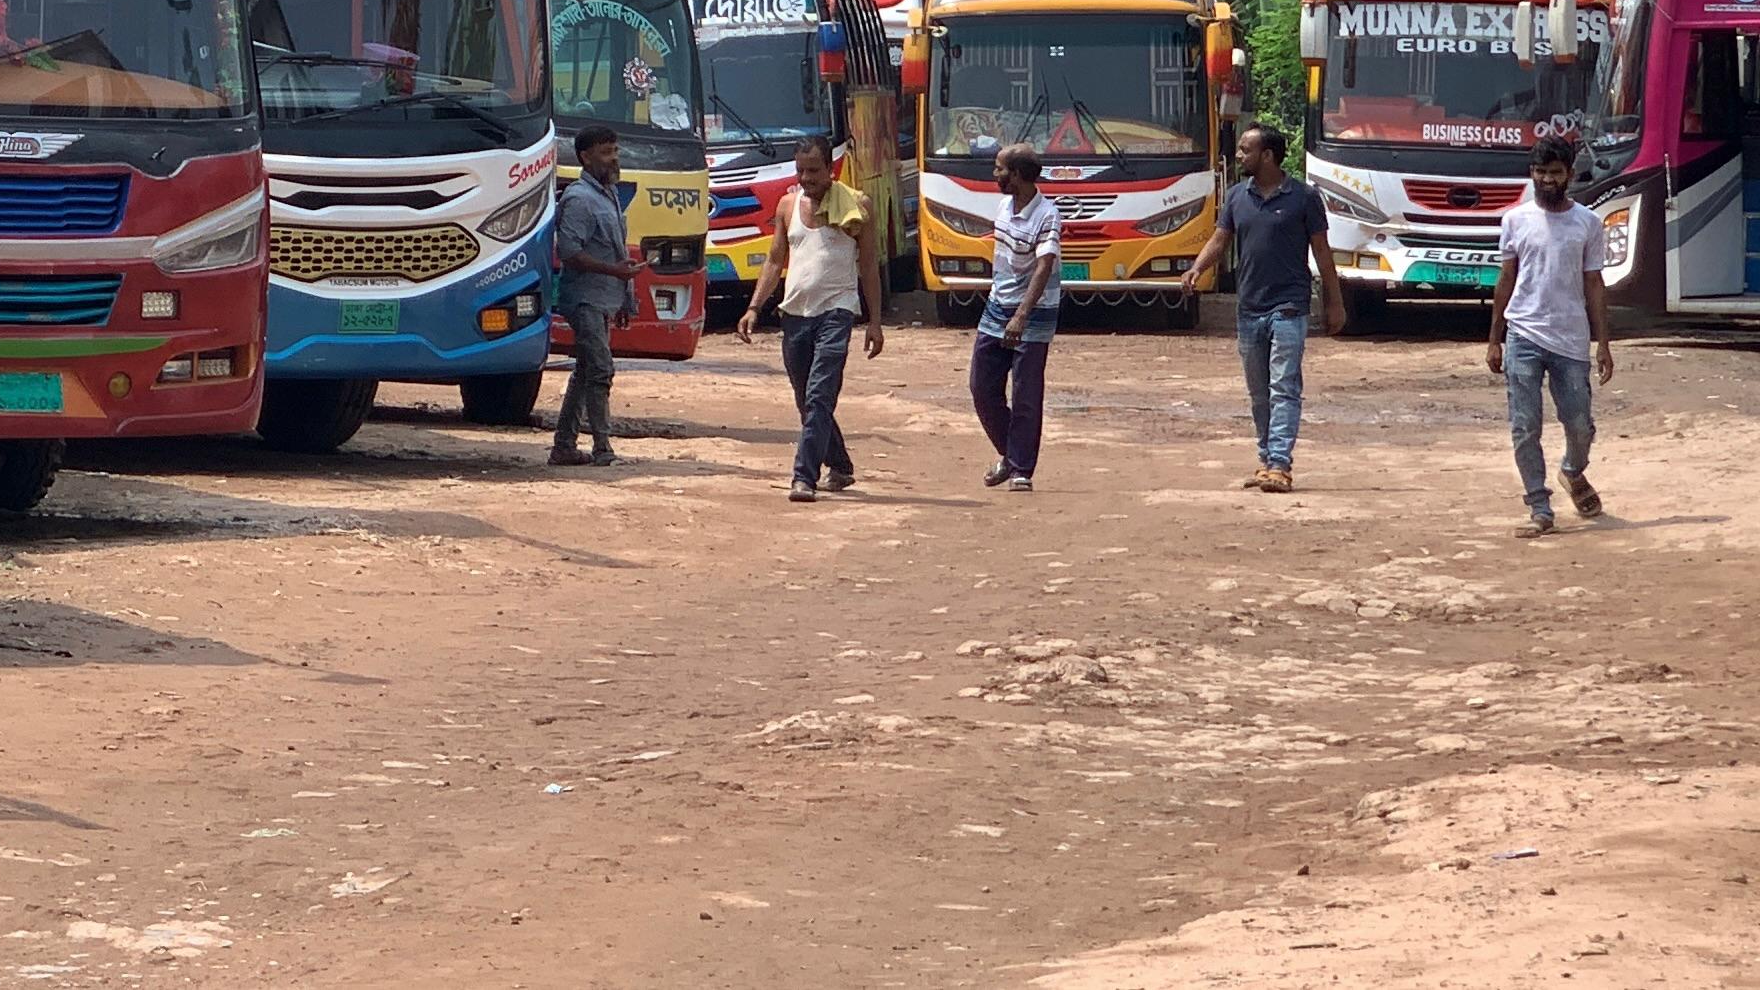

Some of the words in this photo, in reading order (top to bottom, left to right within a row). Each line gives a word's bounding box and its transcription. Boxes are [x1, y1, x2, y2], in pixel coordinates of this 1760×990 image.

[1338, 2, 1458, 37] MUNNA
[1396, 38, 1477, 53] EURO
[1490, 40, 1553, 56] BS
[1423, 123, 1482, 142] BUSINESS
[1483, 126, 1521, 145] CLASS
[647, 188, 701, 214] চয়েস
